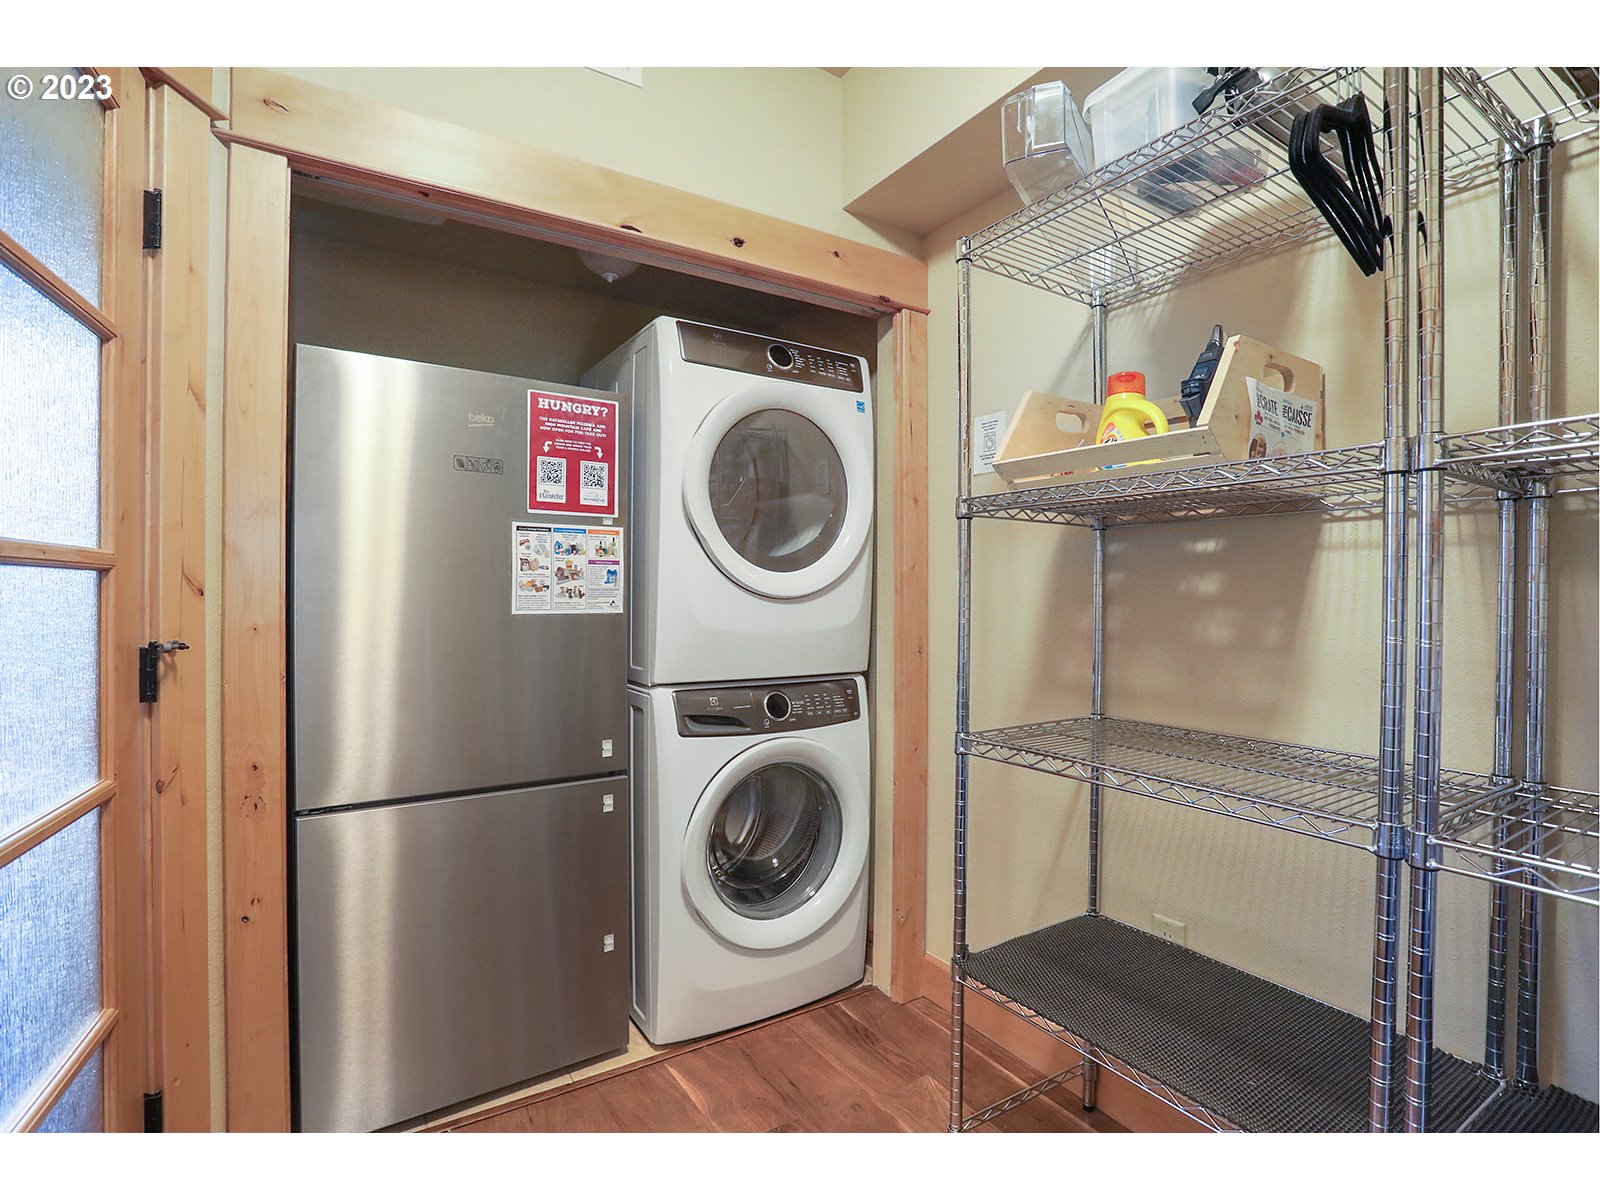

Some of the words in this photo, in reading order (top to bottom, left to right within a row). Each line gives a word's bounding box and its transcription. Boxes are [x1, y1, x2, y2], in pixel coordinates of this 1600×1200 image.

[537, 398, 609, 417] HUNGRY?
[1260, 394, 1279, 416] CRATE
[468, 411, 495, 423] beko
[1288, 406, 1313, 428] CAISSE
